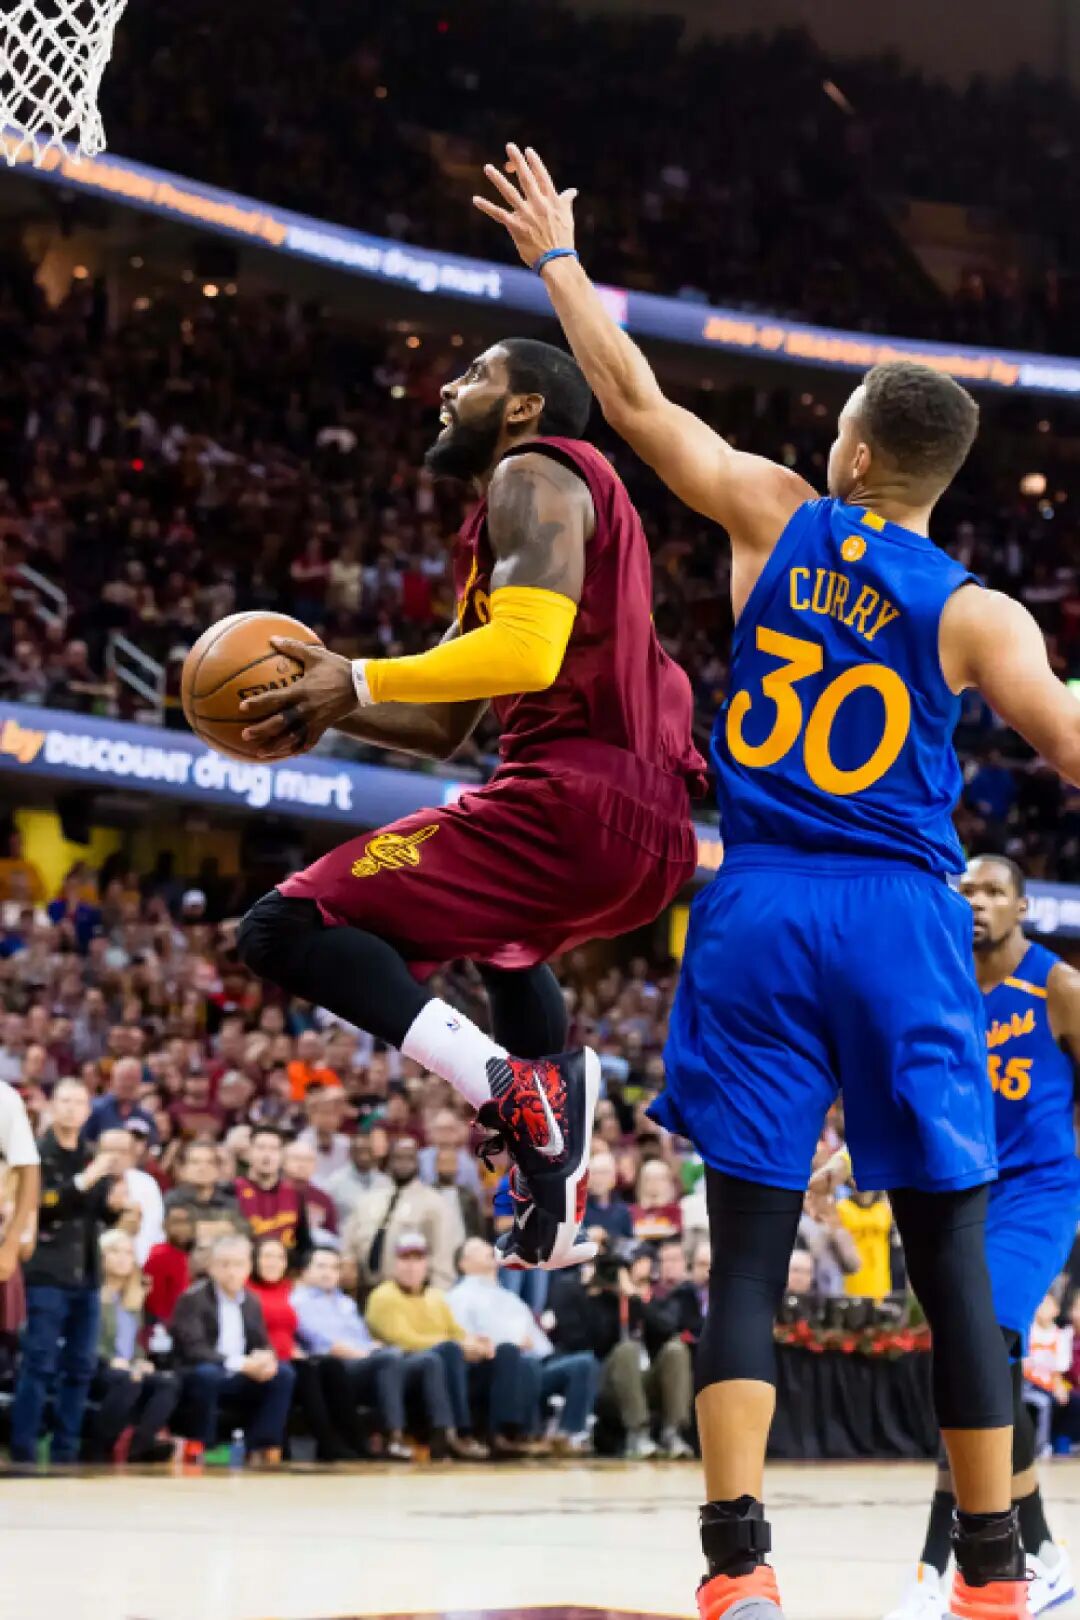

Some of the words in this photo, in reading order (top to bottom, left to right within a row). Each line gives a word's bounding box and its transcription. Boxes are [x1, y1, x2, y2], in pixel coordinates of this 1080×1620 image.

[789, 567, 900, 641] CURRY
[725, 625, 911, 796] 30
[1, 718, 45, 764] by
[45, 729, 191, 784] DISCOUNT
[193, 749, 271, 808] drug
[274, 769, 353, 811] mart
